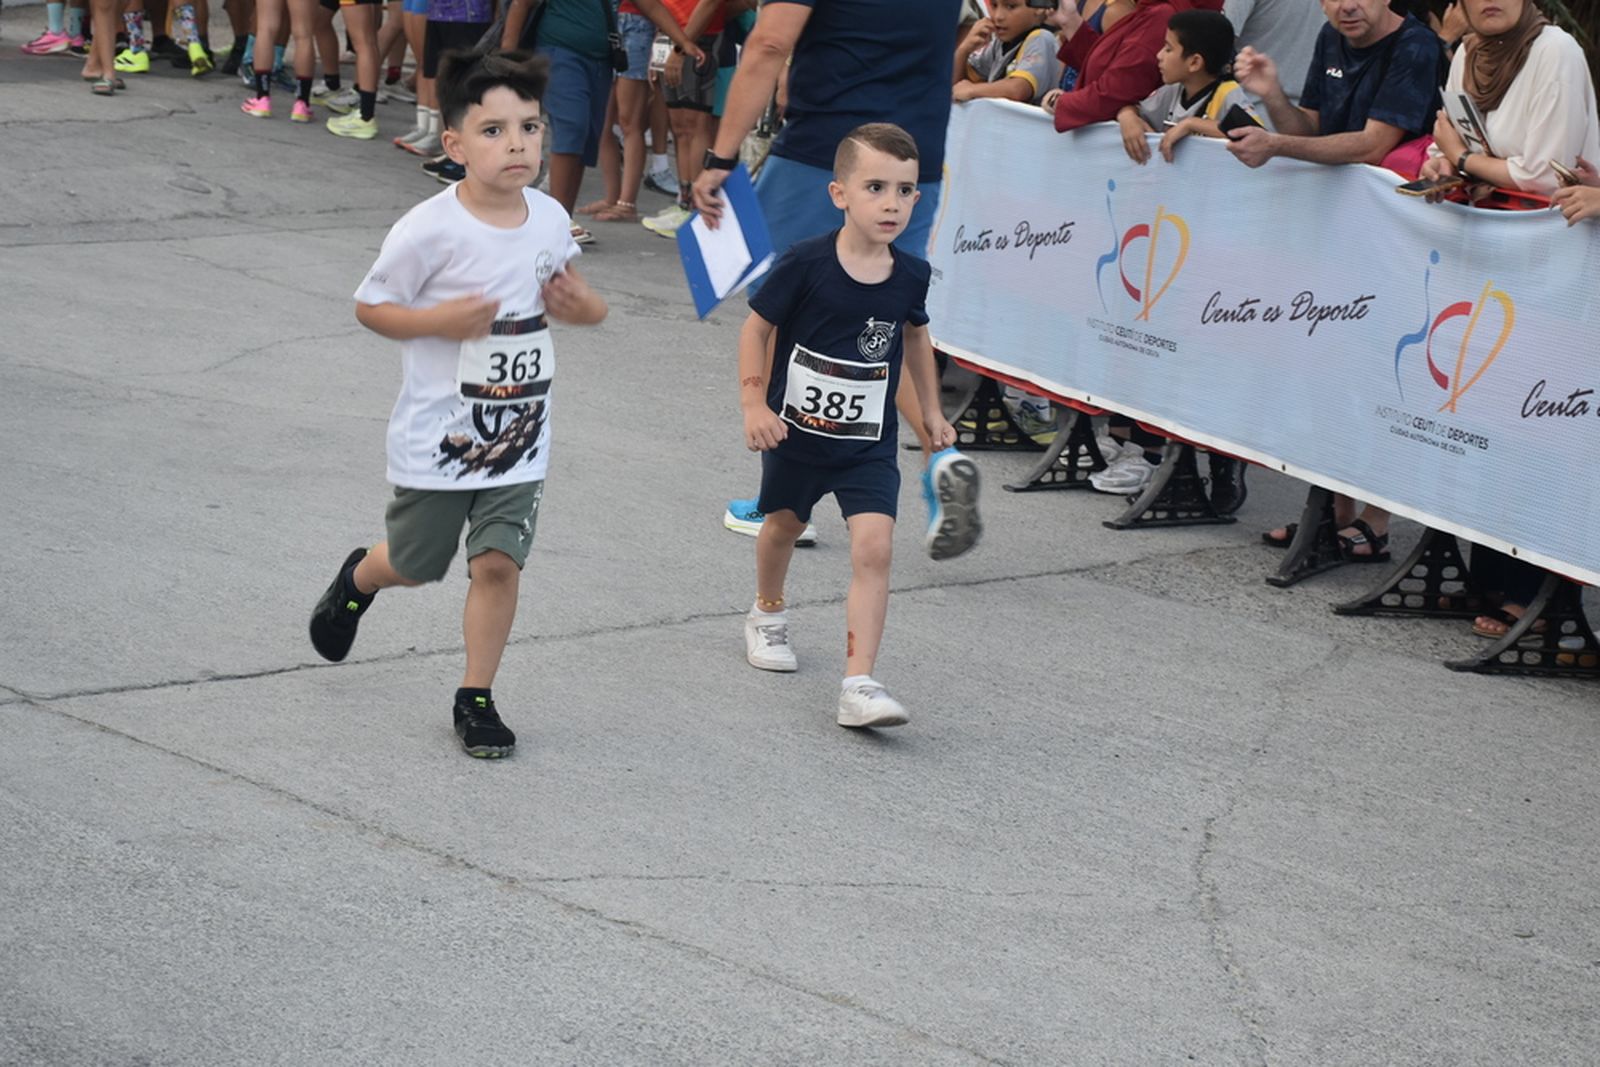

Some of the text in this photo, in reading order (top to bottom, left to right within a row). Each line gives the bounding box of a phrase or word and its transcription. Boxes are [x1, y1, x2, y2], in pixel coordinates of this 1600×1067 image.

[953, 221, 1075, 260] Ceuta es Deporte
[1201, 290, 1376, 336] Ceuta es Deporte
[486, 348, 542, 383] 363
[801, 386, 866, 421] 385
[1521, 379, 1594, 418] Ceuta
[1447, 427, 1490, 450] DEPORTES
